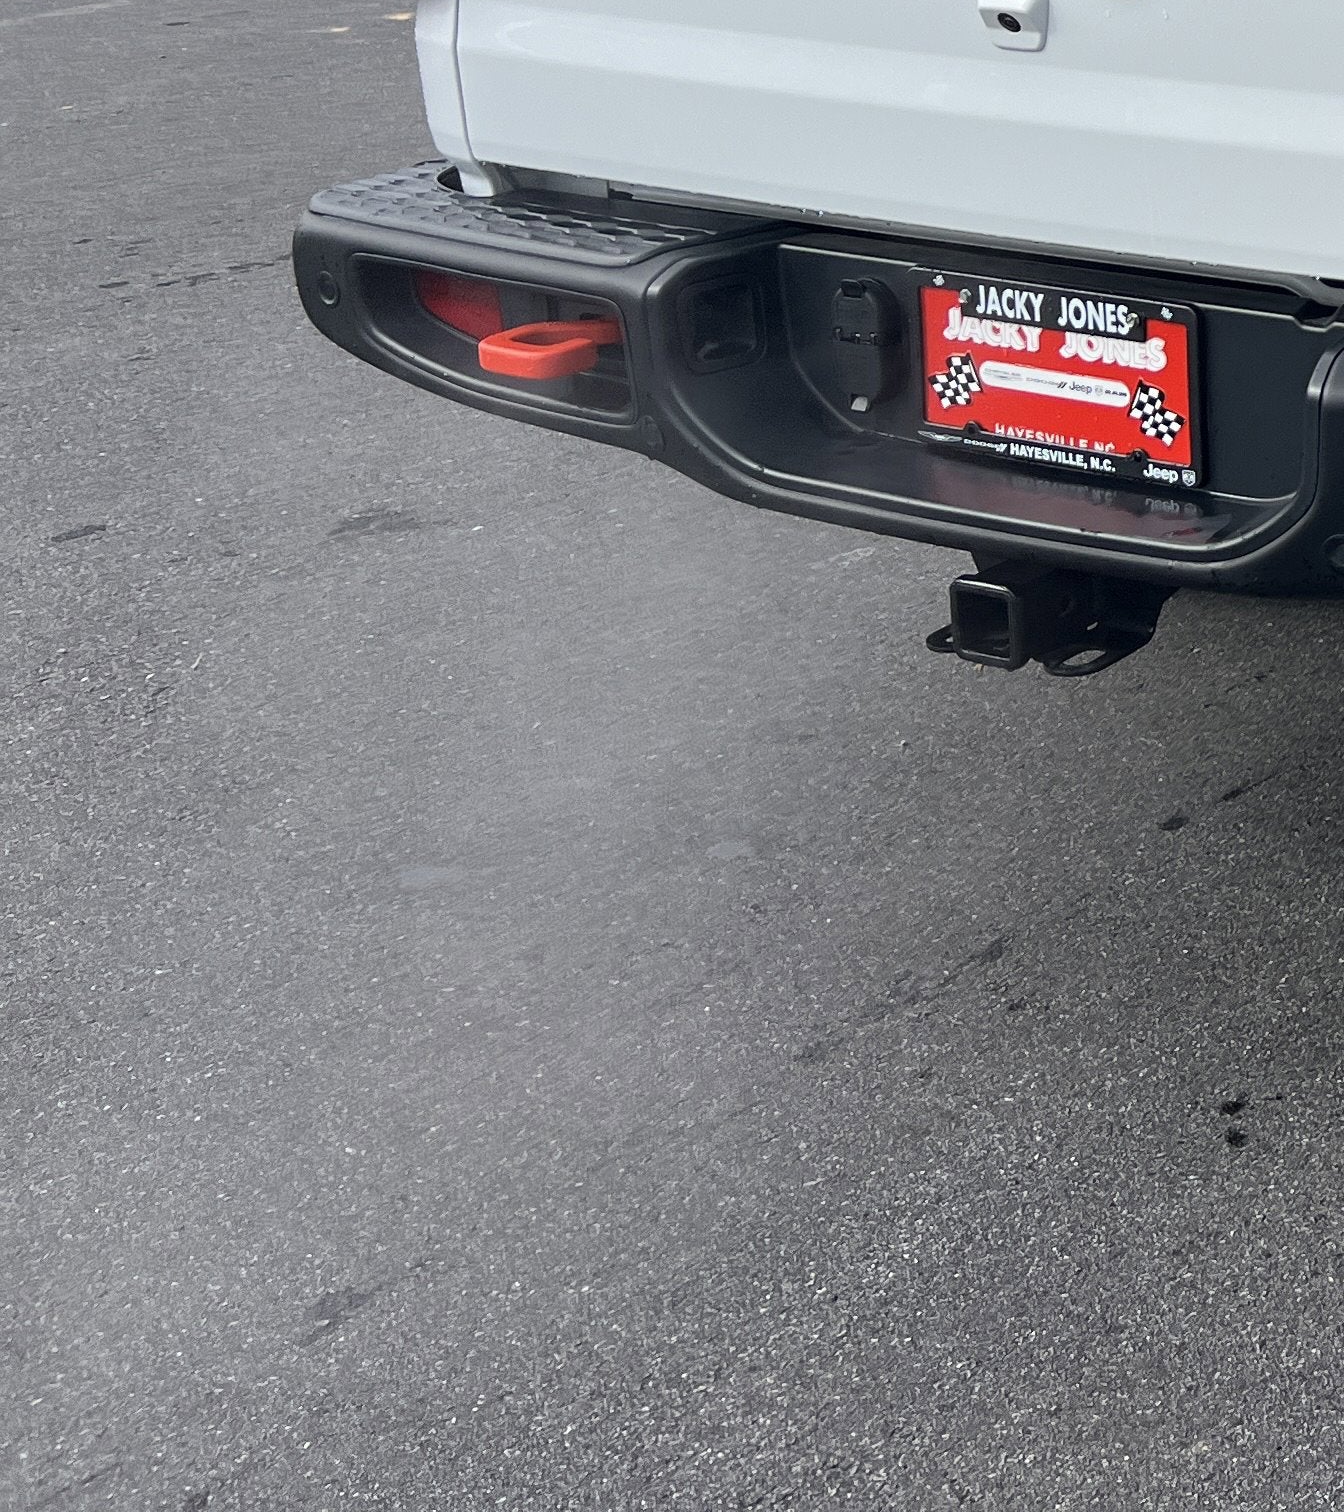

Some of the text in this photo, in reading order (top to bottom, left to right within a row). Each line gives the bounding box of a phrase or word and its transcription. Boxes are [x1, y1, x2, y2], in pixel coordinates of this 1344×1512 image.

[976, 284, 1130, 336] JACKY JONES
[944, 306, 1168, 372] JACKY JONES
[1069, 381, 1093, 395] Jeep
[1010, 442, 1088, 470] HAYESVILLE,
[1090, 456, 1117, 473] N.C.
[1143, 463, 1179, 484] Jeep
